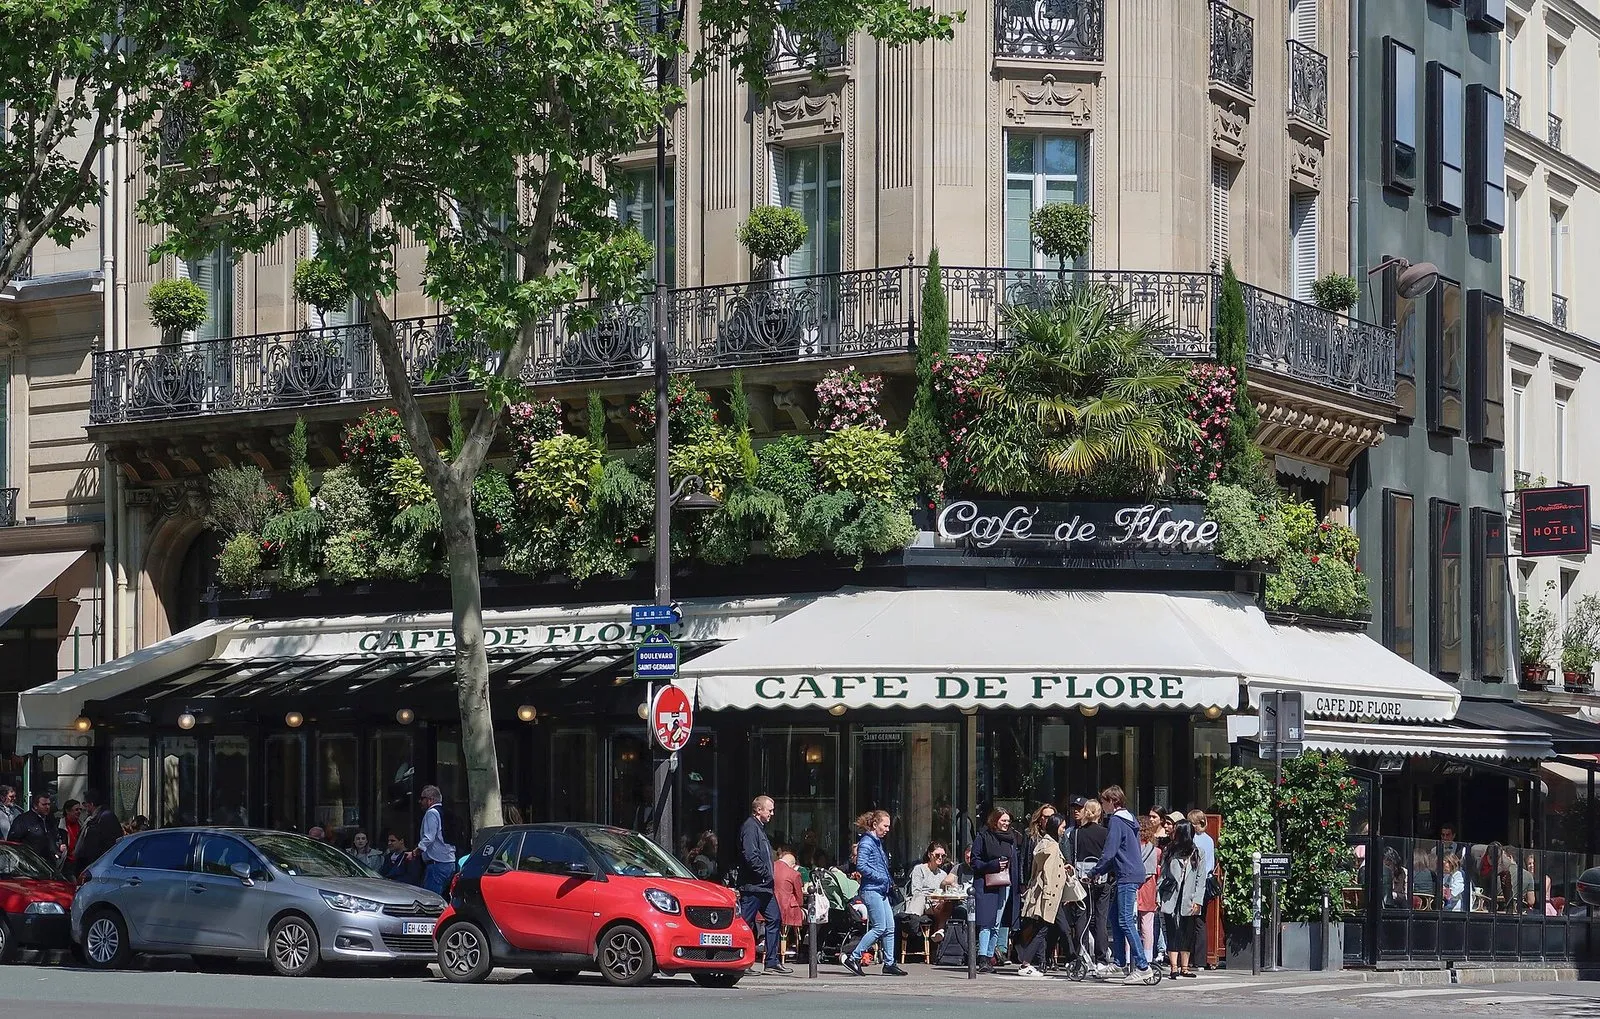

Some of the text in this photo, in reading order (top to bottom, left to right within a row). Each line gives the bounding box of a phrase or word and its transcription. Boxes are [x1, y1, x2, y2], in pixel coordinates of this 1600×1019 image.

[936, 500, 1219, 548] Café de Flore
[1533, 525, 1576, 536] HOTEL
[359, 630, 456, 651] CAFE
[483, 627, 528, 646] DE
[640, 652, 674, 660] BOULEVARD
[755, 675, 1184, 699] CAFE DE FLORE
[1316, 697, 1401, 715] CAFE DE FLORE
